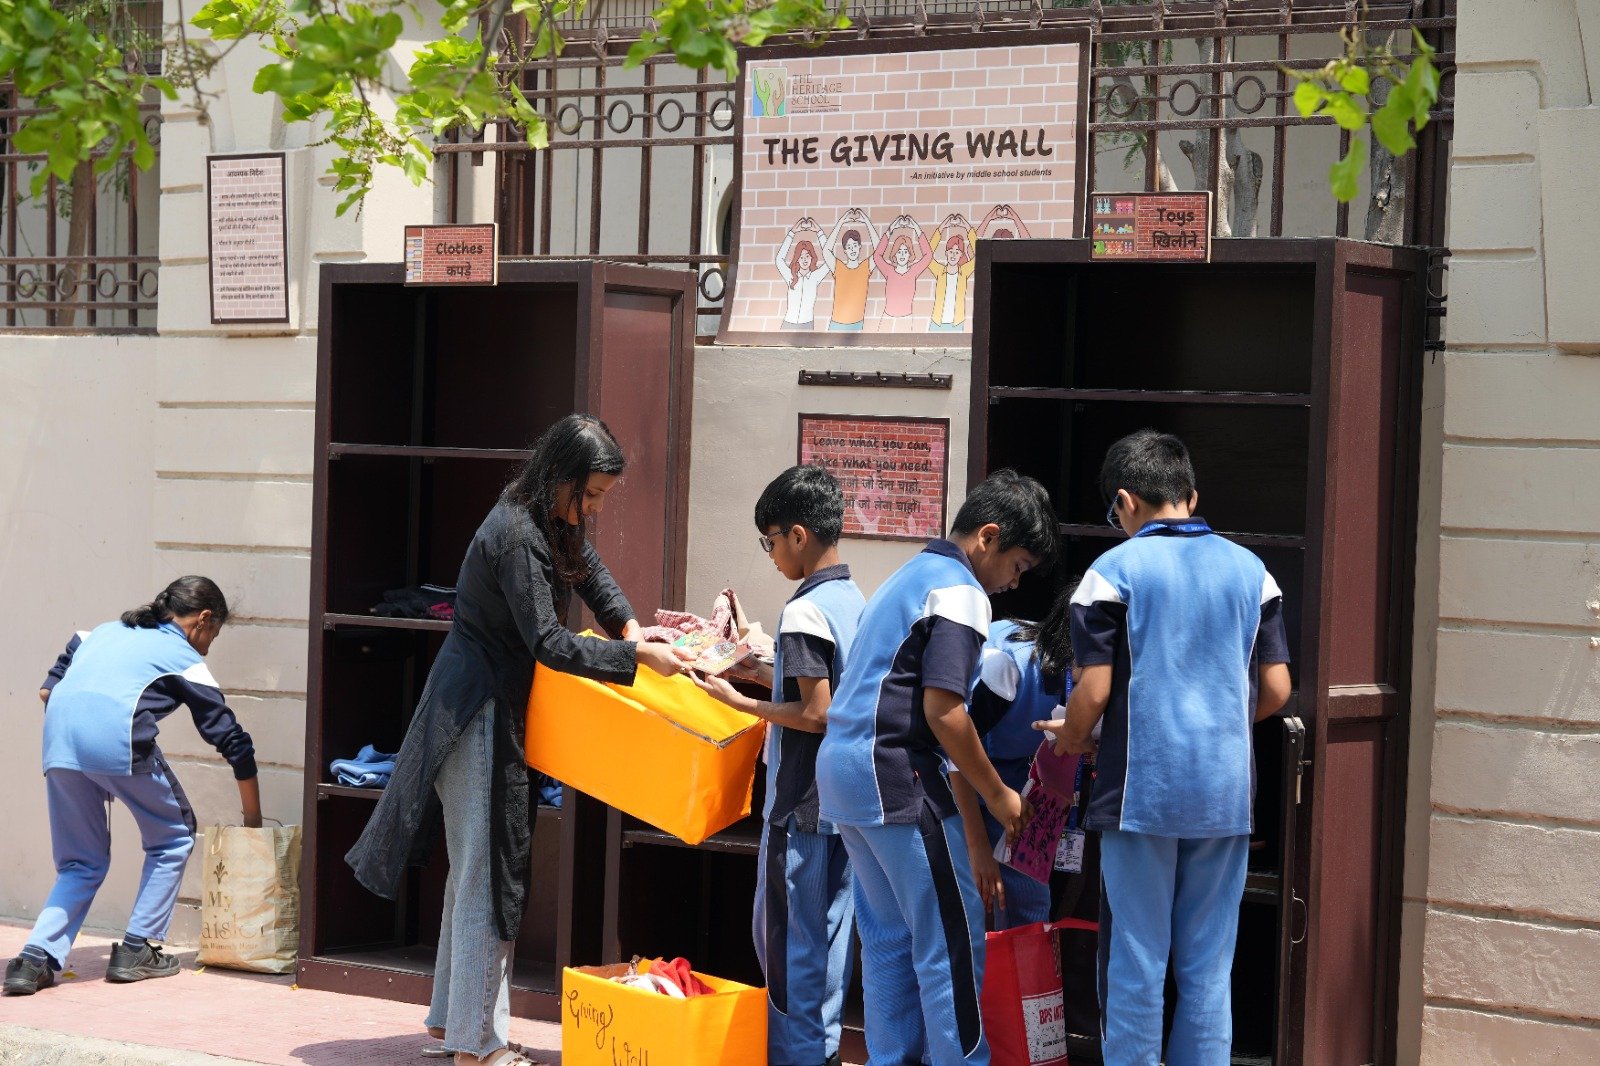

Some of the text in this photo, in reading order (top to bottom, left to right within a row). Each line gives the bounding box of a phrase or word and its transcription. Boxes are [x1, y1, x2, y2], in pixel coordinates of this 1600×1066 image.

[793, 74, 813, 84] THE
[792, 83, 842, 95] HERITAGE
[791, 95, 830, 105] SCHOOL
[763, 128, 1053, 166] THE GIVING WALL
[924, 171, 954, 180] initiative
[955, 171, 965, 180] by
[966, 170, 991, 178] middle
[993, 169, 1018, 177] school
[1019, 168, 1052, 177] students
[1157, 208, 1195, 227] Toys
[436, 242, 484, 254] Clothes
[446, 262, 472, 279] कपड़े
[813, 435, 931, 453] Leave what you can,
[843, 459, 872, 469] what
[876, 460, 896, 473] you
[900, 460, 932, 472] need!
[862, 476, 874, 489] जो
[858, 496, 870, 509] जो
[208, 891, 232, 912] My
[565, 990, 613, 1049] Giving
